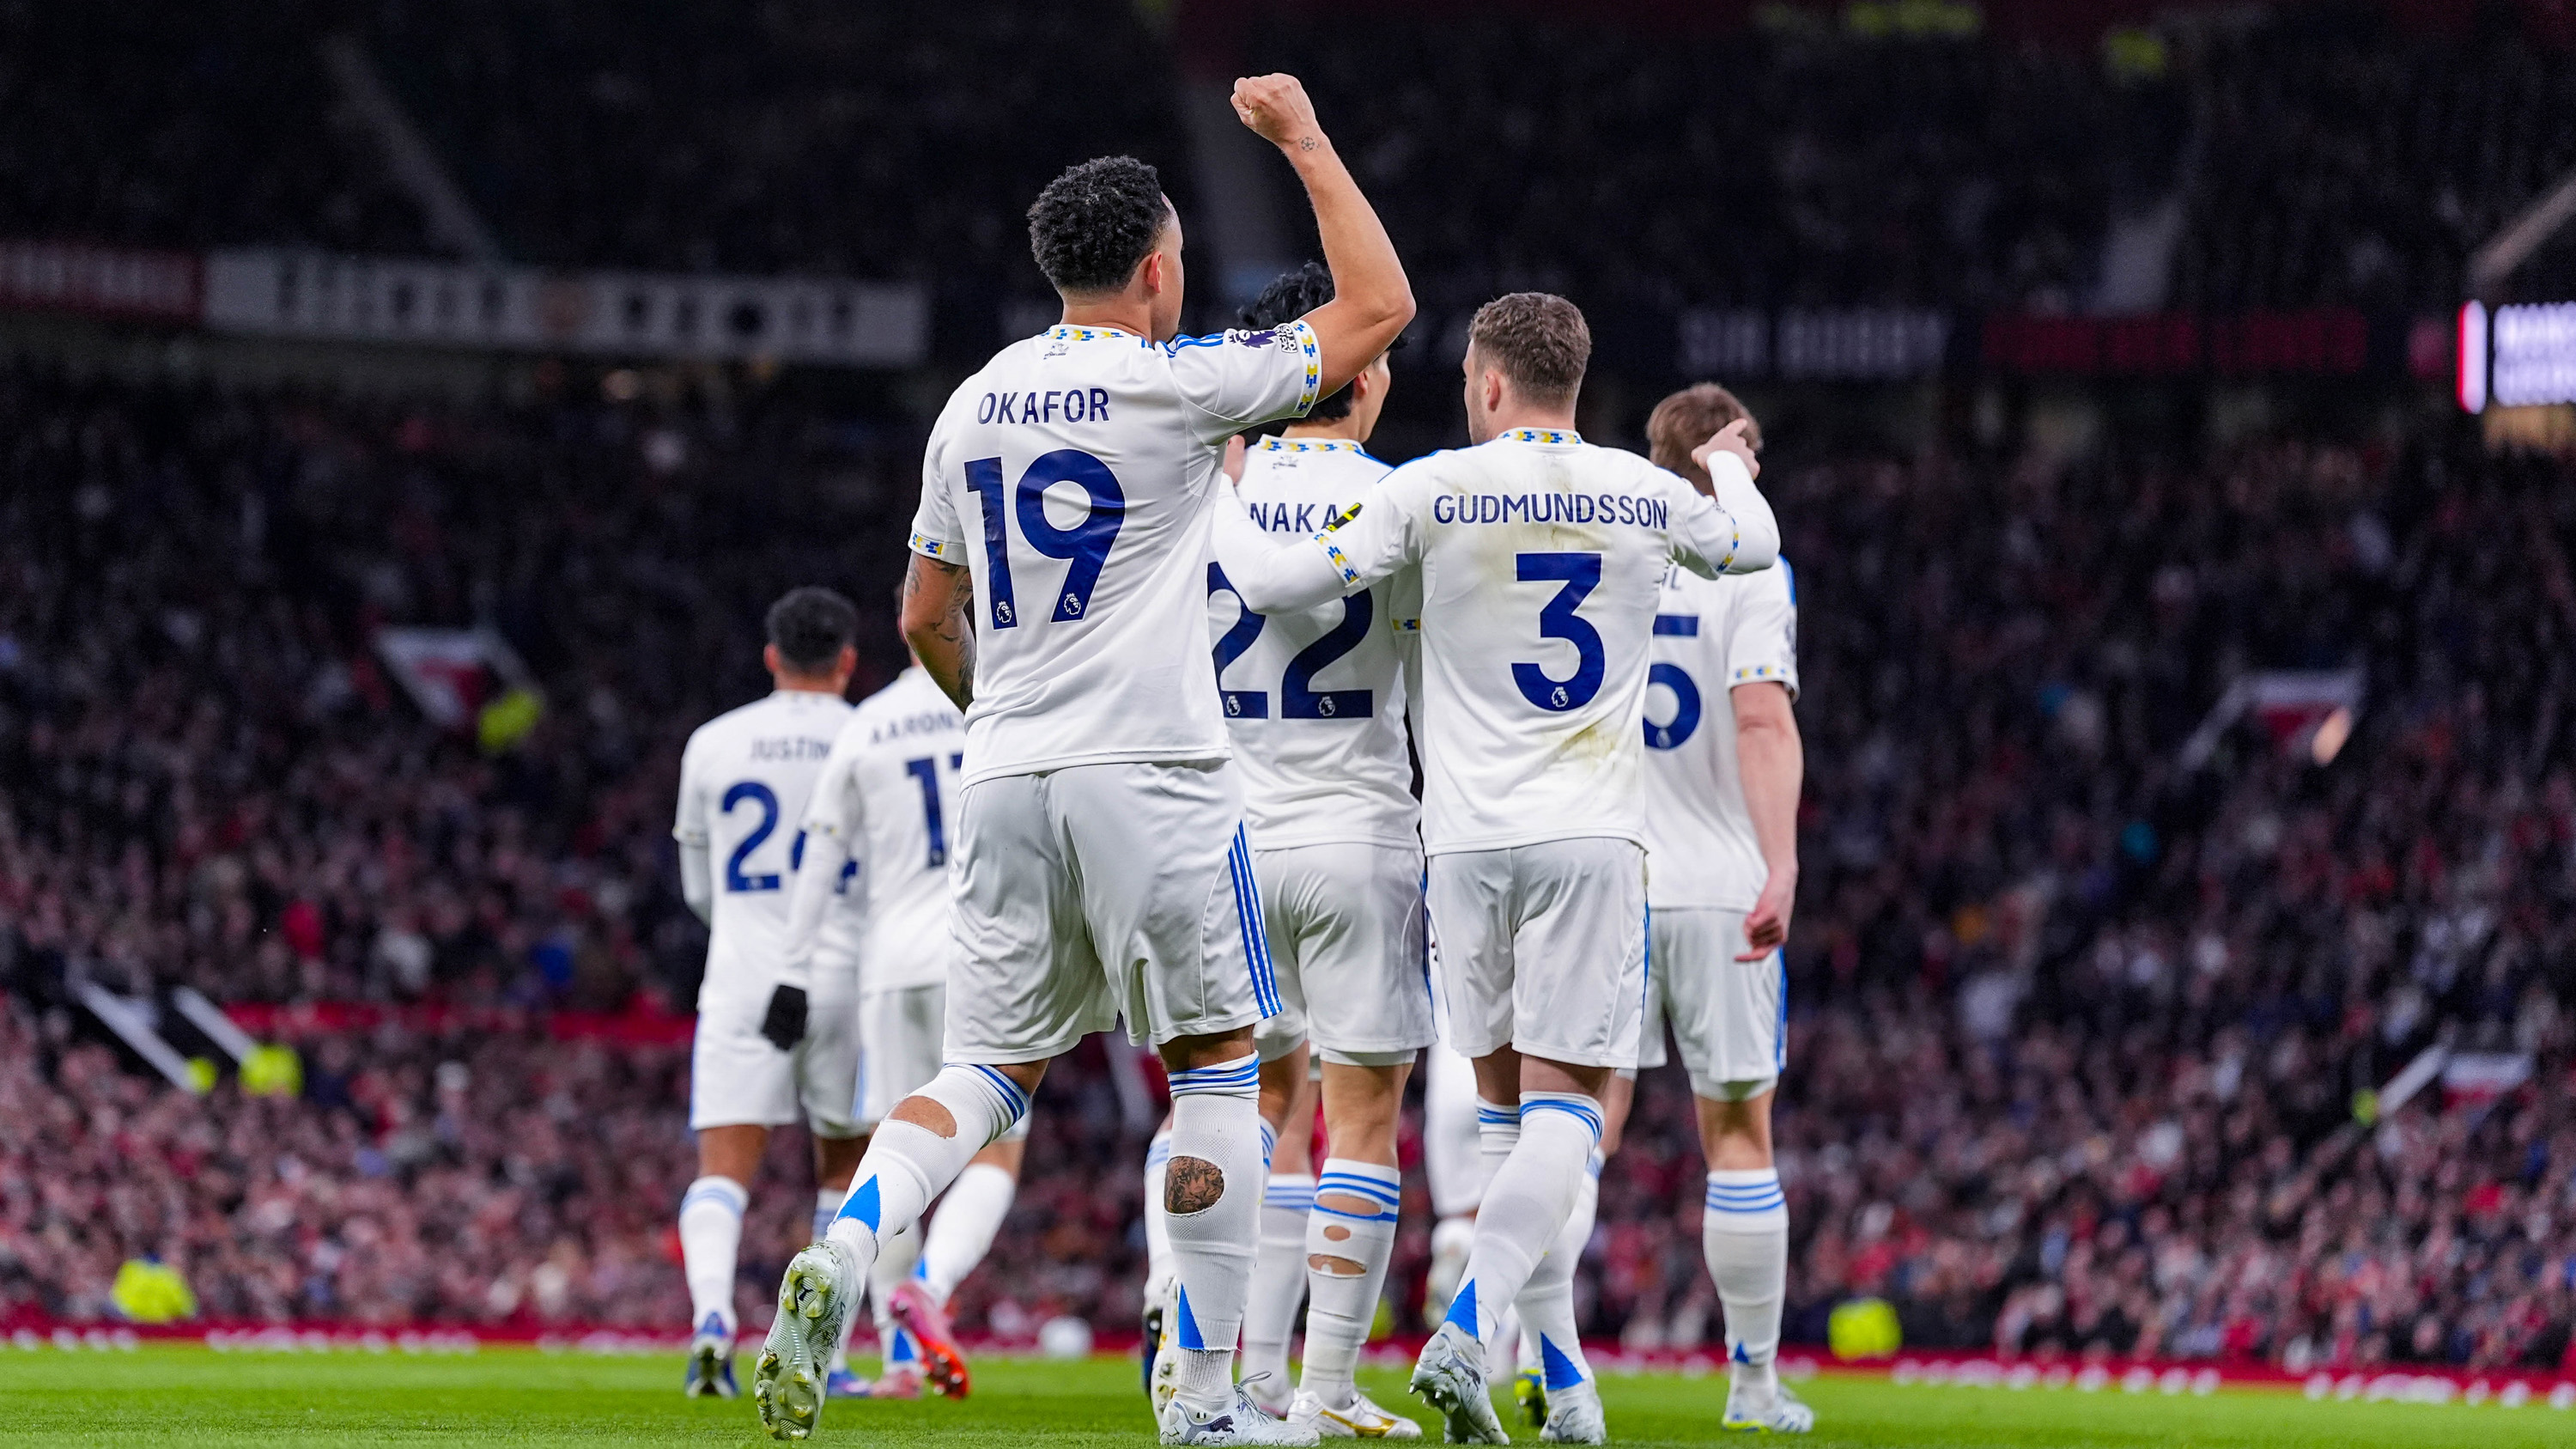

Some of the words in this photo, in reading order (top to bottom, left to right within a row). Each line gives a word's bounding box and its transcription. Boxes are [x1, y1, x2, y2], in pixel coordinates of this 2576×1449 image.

[977, 387, 1112, 425] OKAFOR
[963, 448, 1127, 630] 19
[1433, 493, 1668, 531] GUDMUNDSSON
[1206, 560, 1376, 721] 22
[1510, 552, 1606, 713] 3
